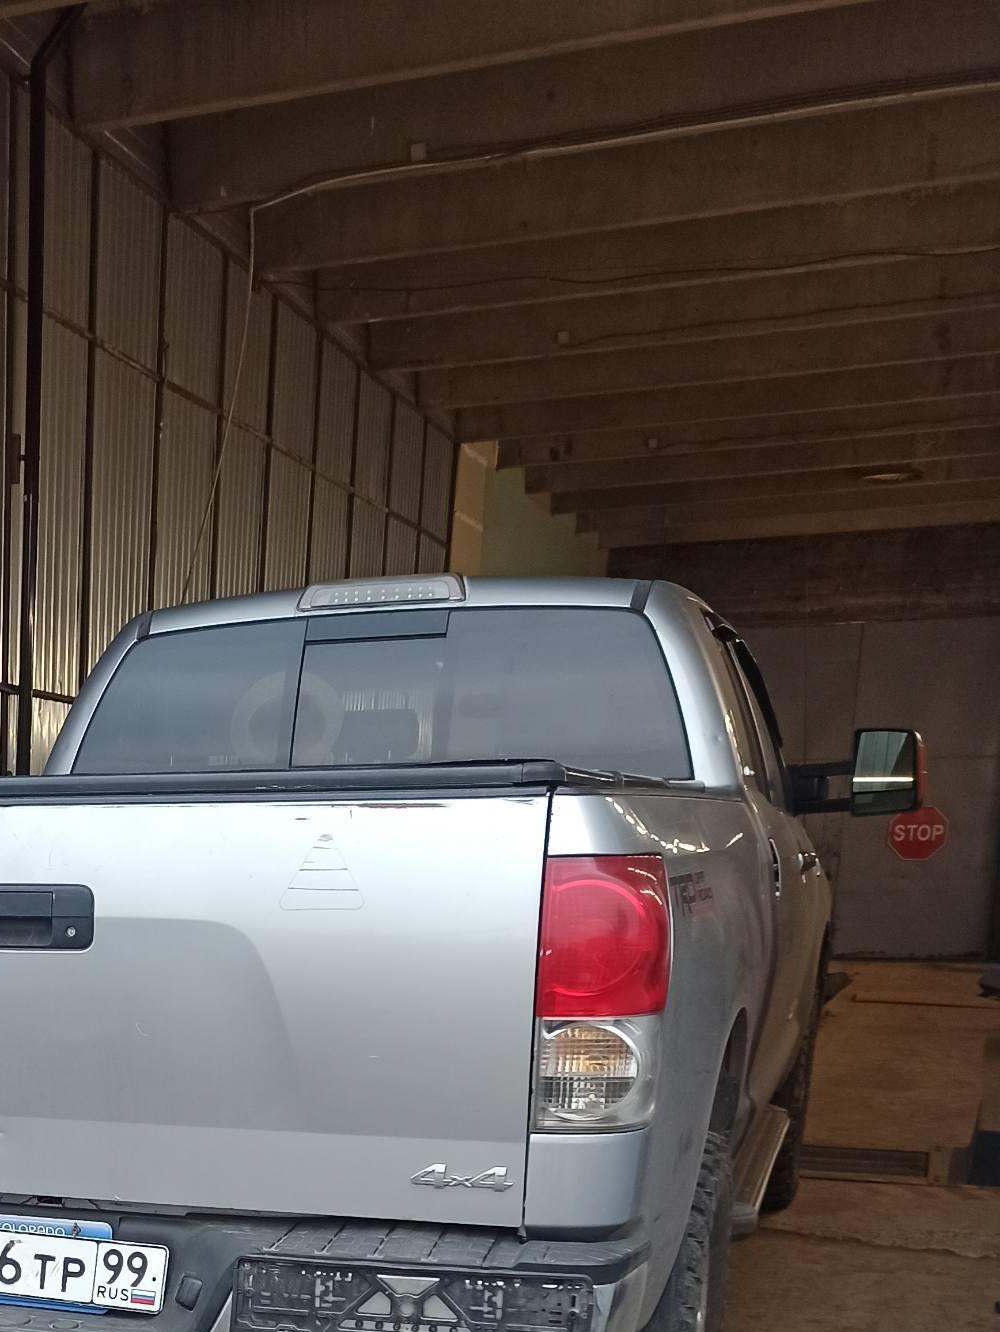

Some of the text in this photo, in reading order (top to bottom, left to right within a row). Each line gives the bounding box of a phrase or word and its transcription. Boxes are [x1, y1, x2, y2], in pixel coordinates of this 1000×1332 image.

[893, 824, 944, 841] STOP
[410, 1162, 514, 1192] 4x4
[102, 1248, 149, 1288] 99
[96, 1285, 129, 1302] RUS
